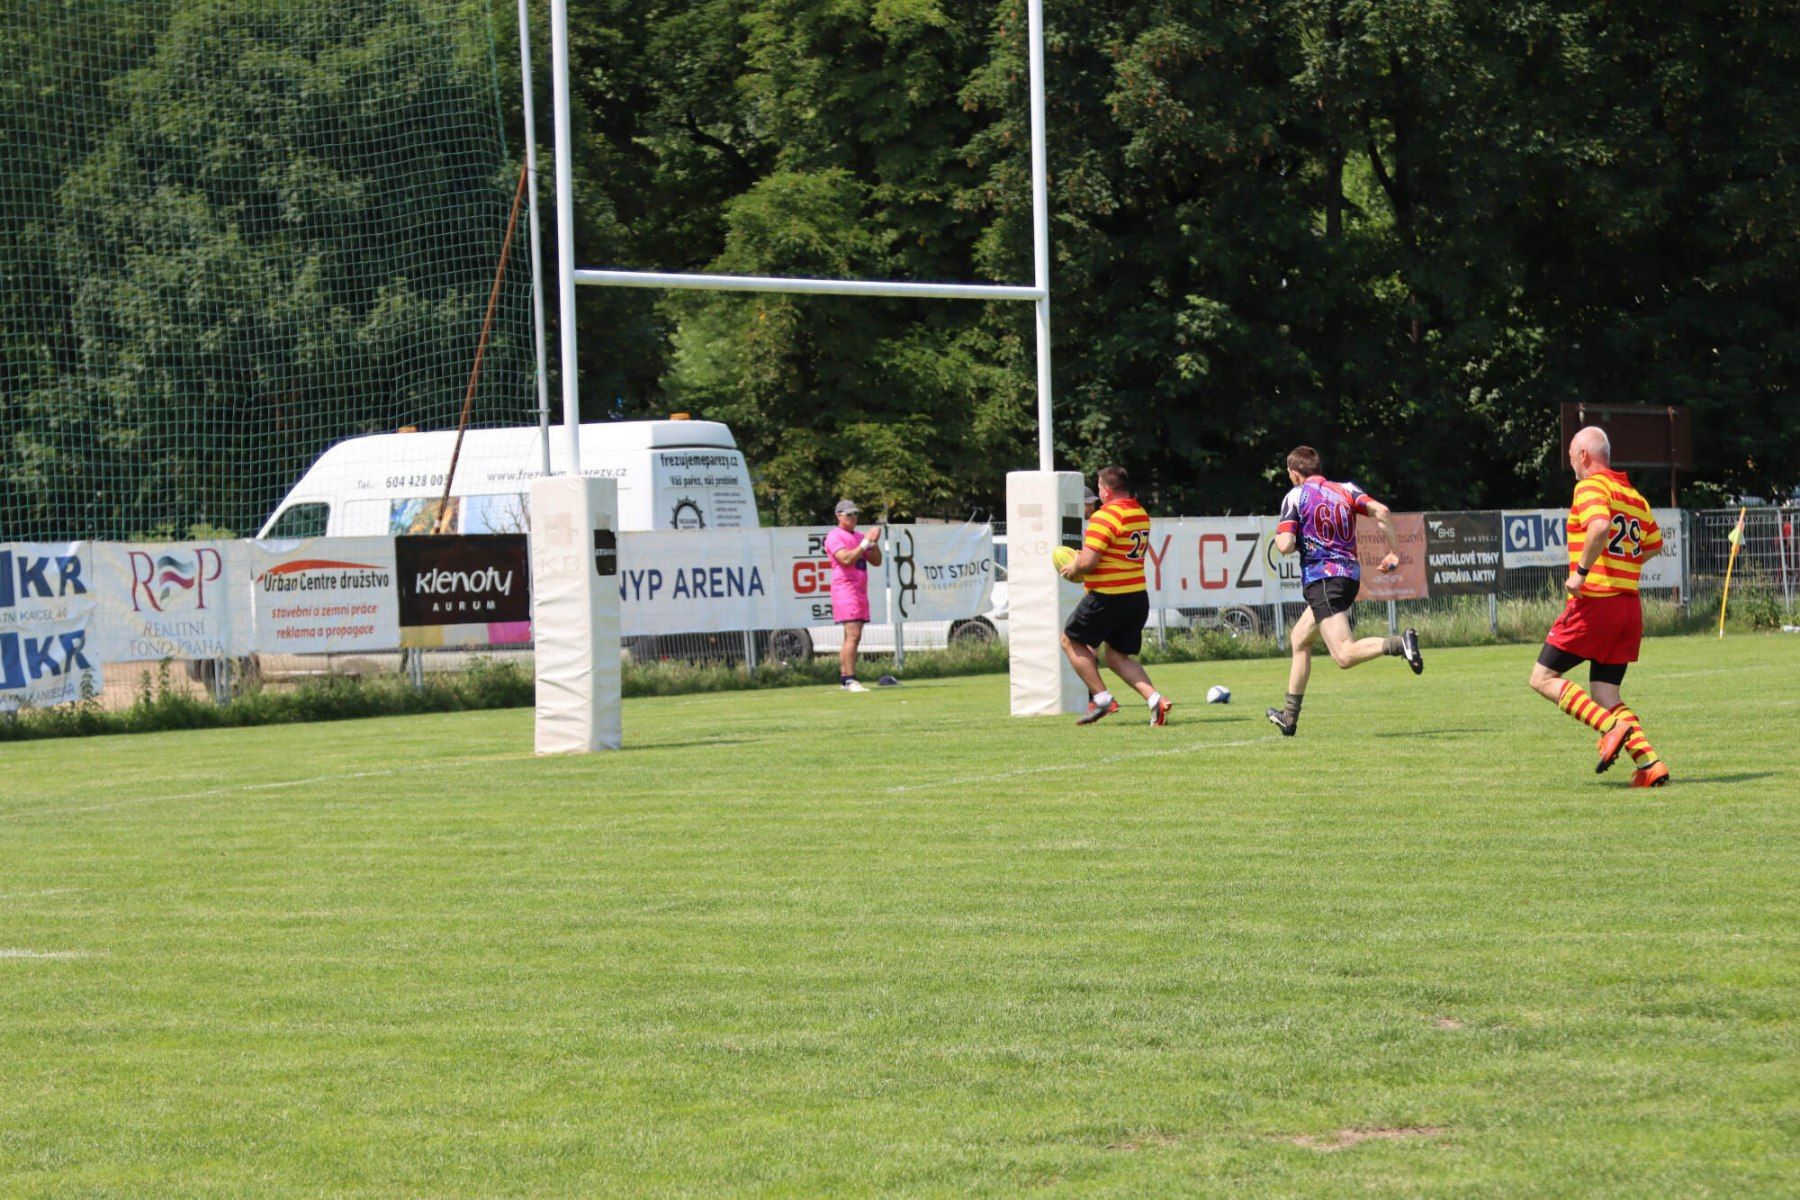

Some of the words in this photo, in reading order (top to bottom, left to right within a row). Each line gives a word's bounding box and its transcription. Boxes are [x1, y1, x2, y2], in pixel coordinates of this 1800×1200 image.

[660, 452, 739, 469] frezujemeparezy.cz
[386, 476, 405, 488] 604
[408, 475, 427, 487] 428
[1313, 501, 1355, 545] 60
[1608, 513, 1643, 558] 29
[1125, 530, 1150, 559] 27
[1429, 549, 1477, 566] KAPITÁLOVÉ
[1476, 552, 1500, 565] TRHY
[264, 574, 299, 592] Urban
[300, 572, 337, 591] Centre
[340, 569, 389, 589] družstvo
[923, 564, 944, 580] TDT
[1434, 572, 1441, 585] A
[1441, 568, 1472, 584] SPRÁVA
[1472, 569, 1497, 583] AKTIV
[672, 565, 765, 600] ARENA
[272, 604, 312, 619] stavební
[313, 608, 319, 616] a
[321, 603, 350, 616] zemní
[351, 603, 377, 618] práce
[432, 600, 496, 612] AURUM
[276, 626, 316, 638] reklama
[317, 628, 323, 637] a
[326, 624, 375, 638] propagace
[130, 639, 173, 656] FOND
[177, 639, 224, 654] PRAHA
